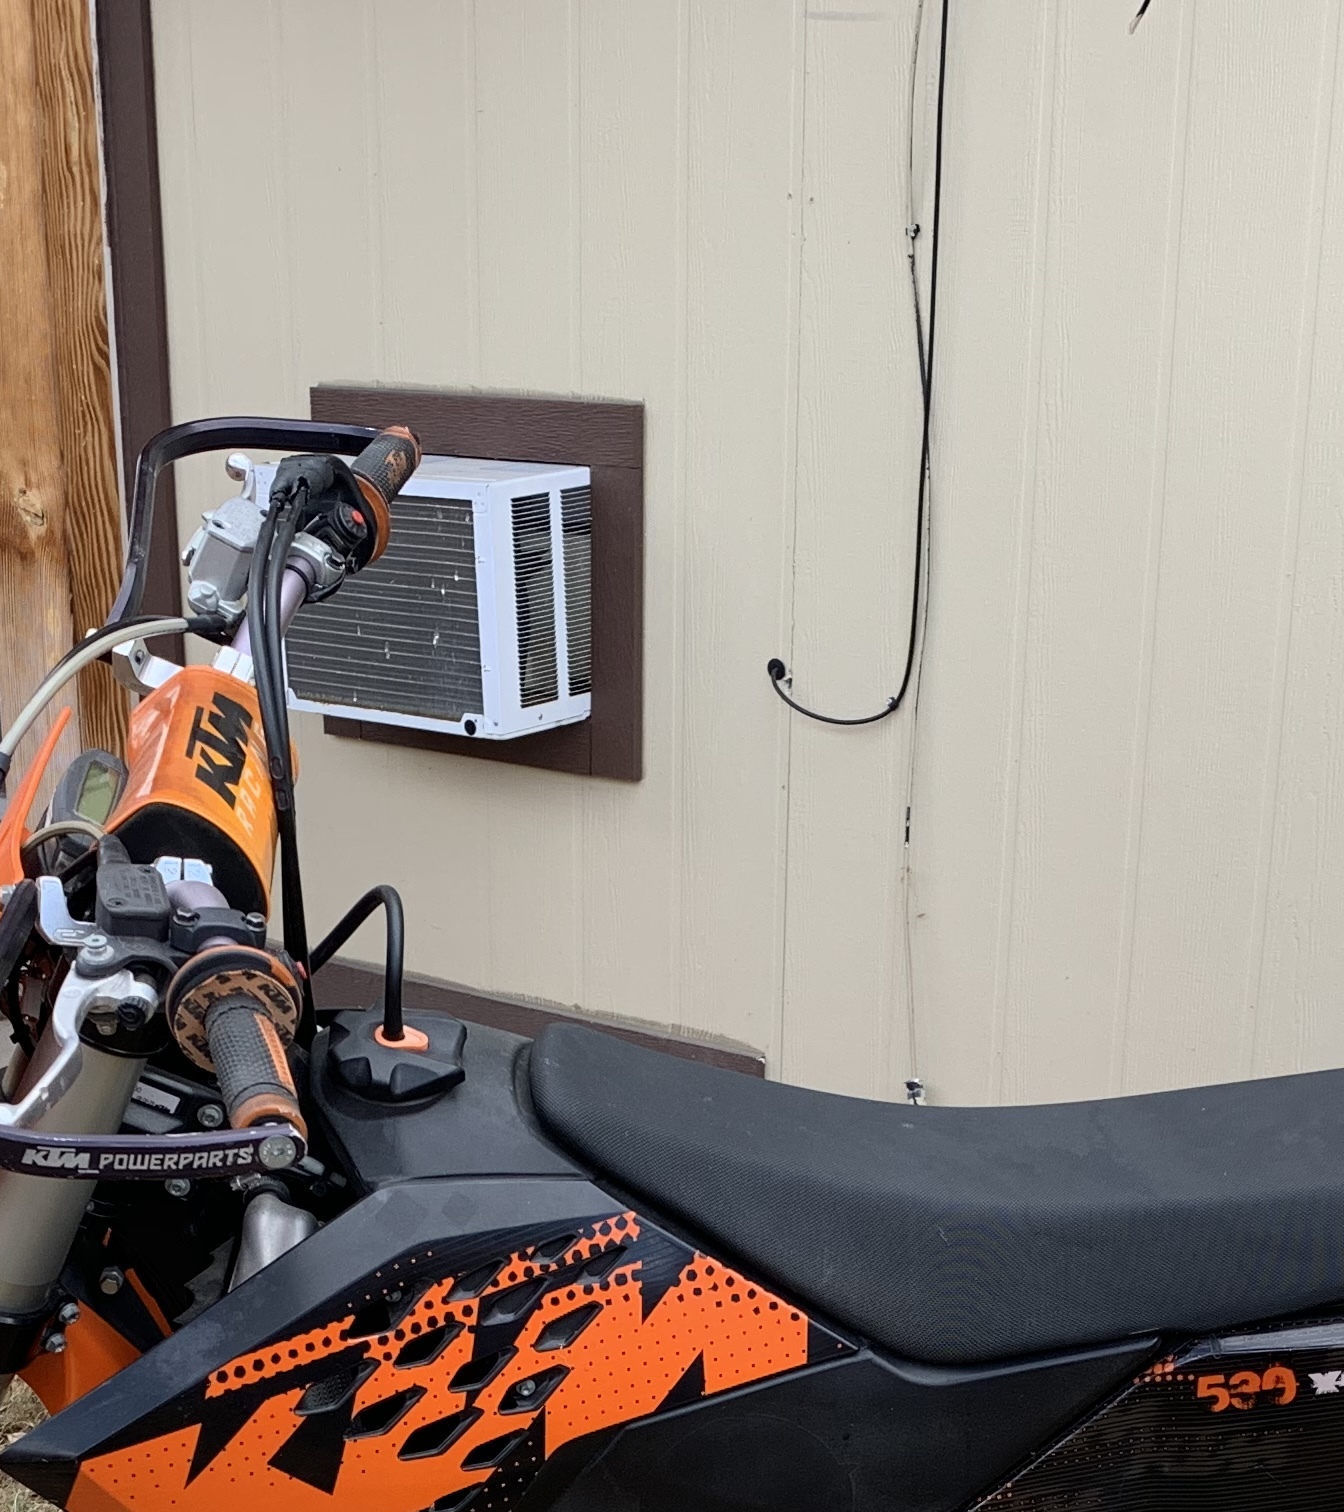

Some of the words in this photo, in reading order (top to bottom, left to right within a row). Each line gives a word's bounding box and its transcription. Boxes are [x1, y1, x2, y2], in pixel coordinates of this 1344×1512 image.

[185, 691, 254, 810] KTM
[21, 1145, 90, 1169] KTM
[98, 1146, 254, 1170] POWERPARTS
